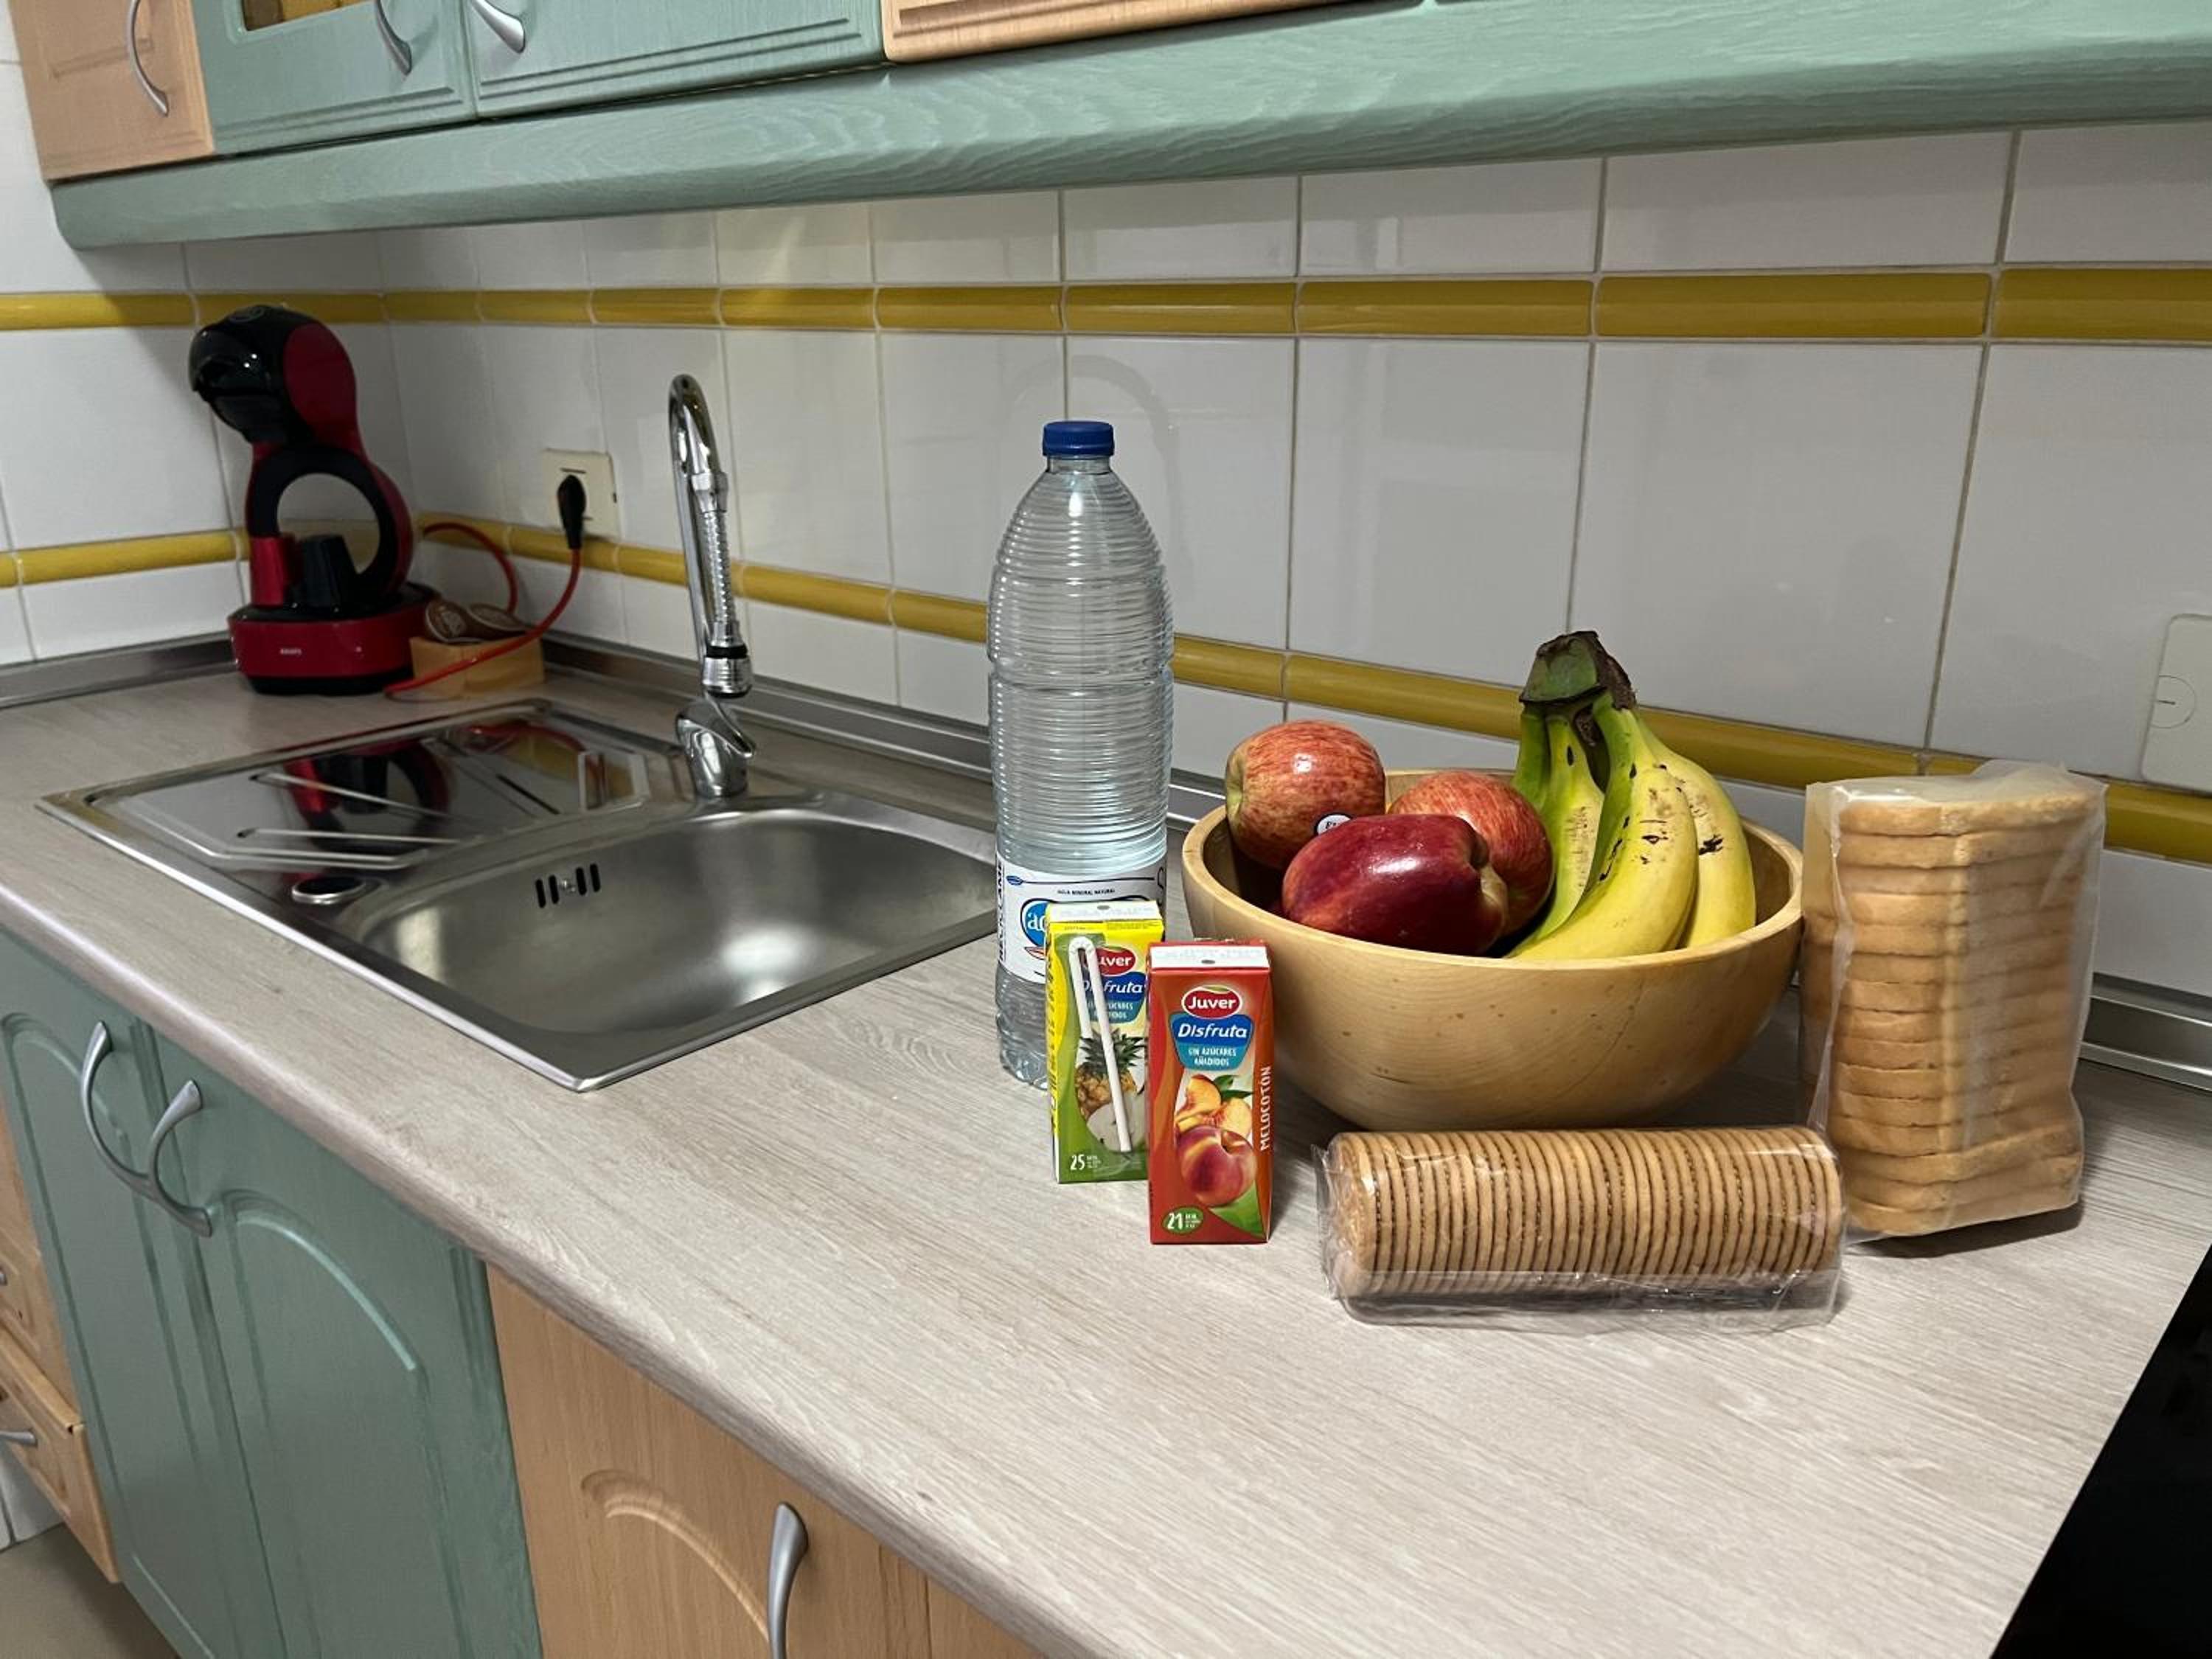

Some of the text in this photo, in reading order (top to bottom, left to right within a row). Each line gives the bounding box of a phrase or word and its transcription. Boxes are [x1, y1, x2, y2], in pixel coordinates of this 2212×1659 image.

[1099, 957, 1133, 967] uver
[1188, 996, 1237, 1009] Juver
[1178, 1023, 1248, 1038] Disfruta
[1070, 1154, 1085, 1171] 25
[1167, 1213, 1183, 1230] 21
